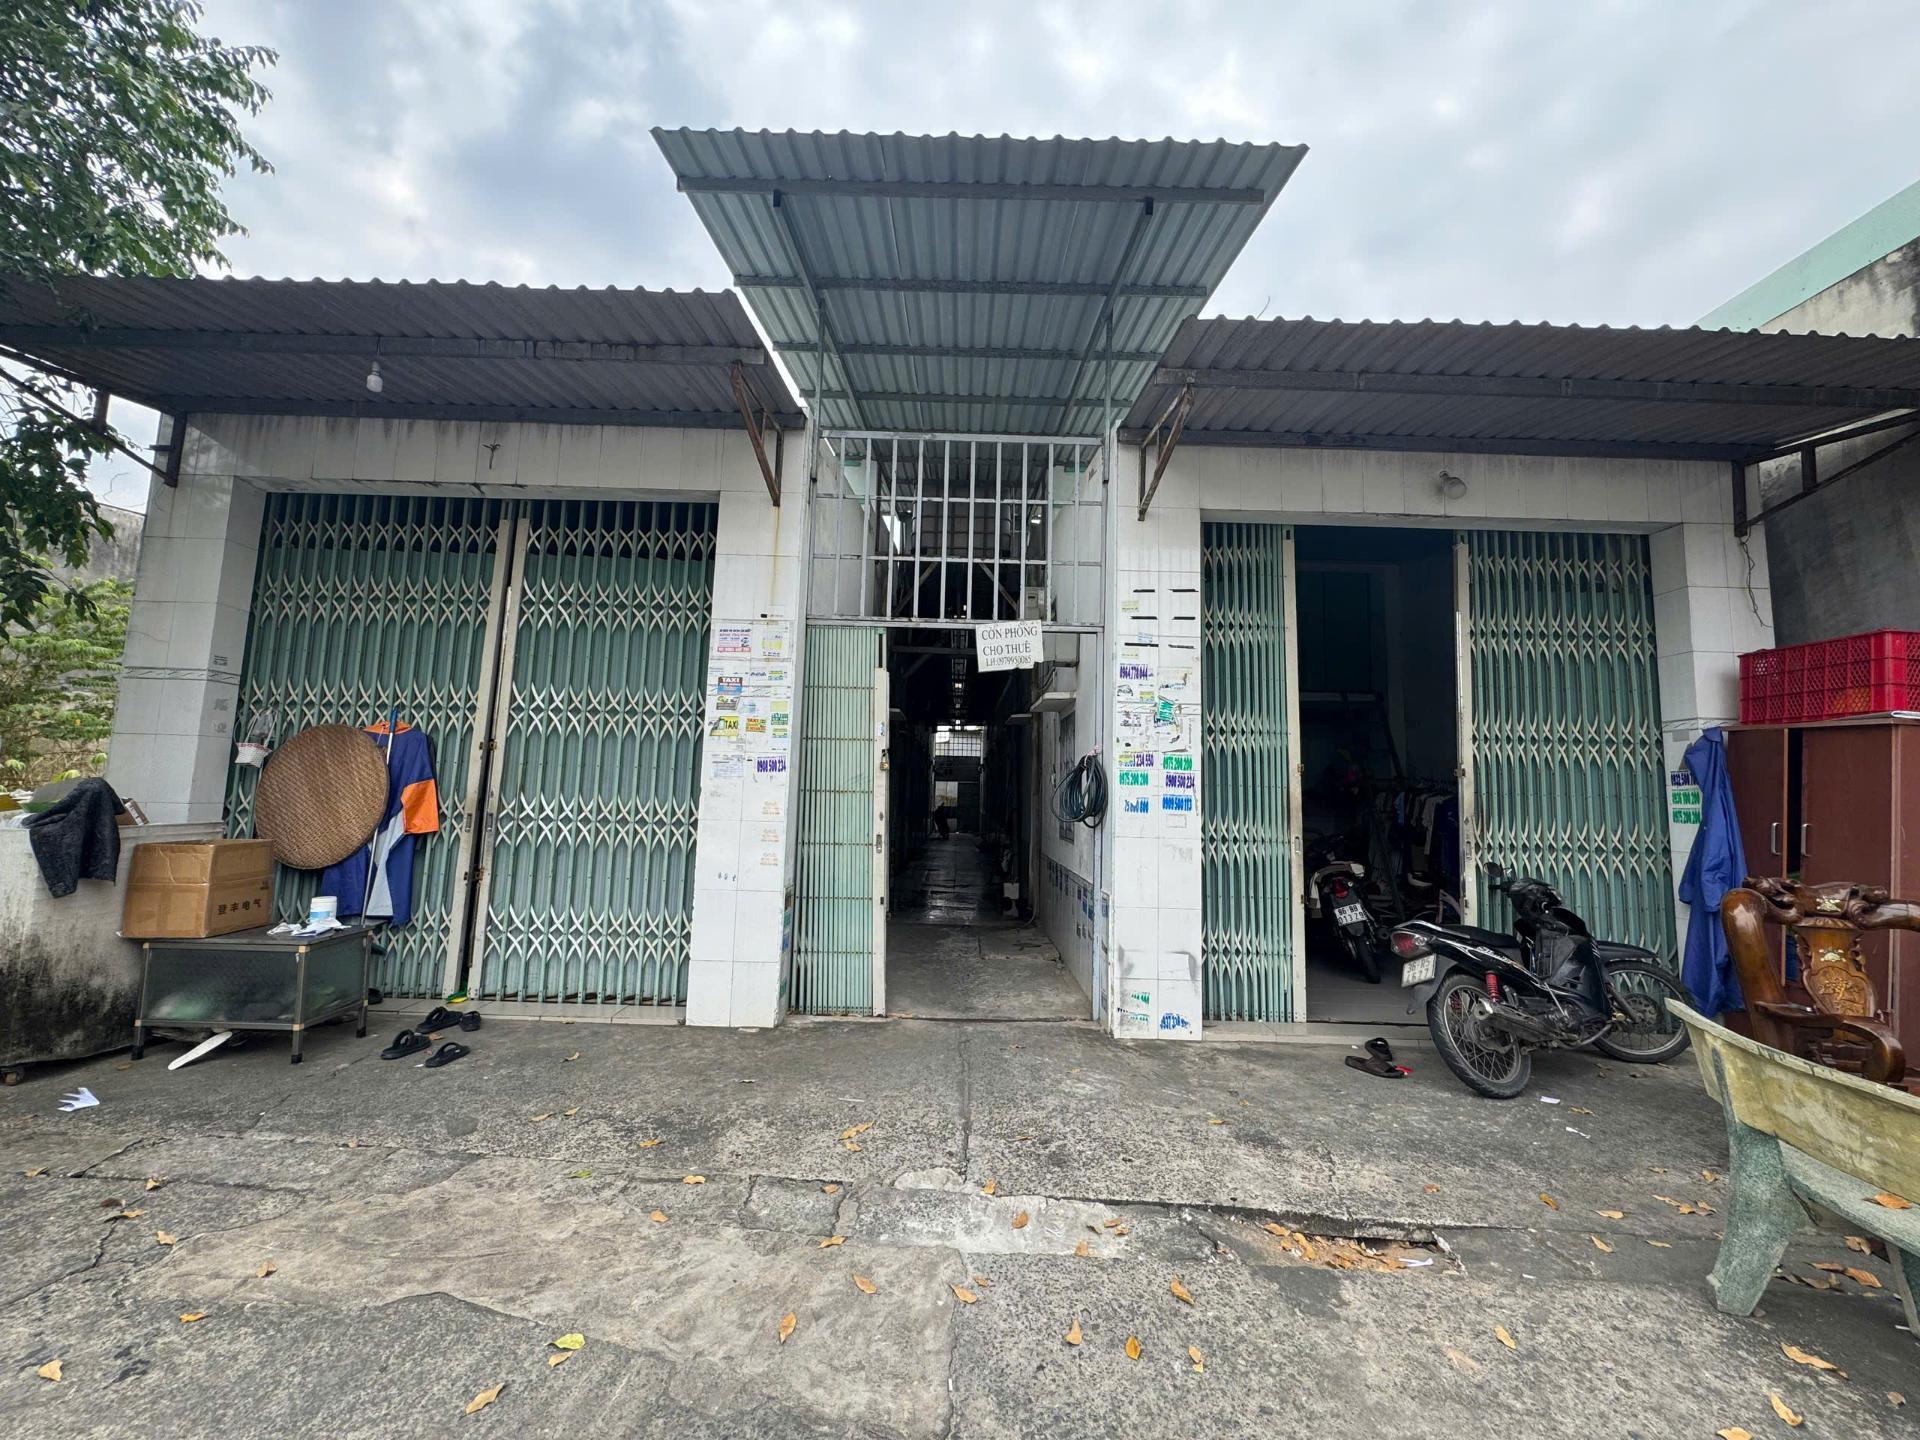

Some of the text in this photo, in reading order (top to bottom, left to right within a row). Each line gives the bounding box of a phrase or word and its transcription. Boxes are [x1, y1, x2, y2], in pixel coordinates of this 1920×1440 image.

[1004, 623, 1038, 639] PHÒNG
[982, 640, 1032, 657] CHO THUÊ
[725, 719, 739, 730] TAXI
